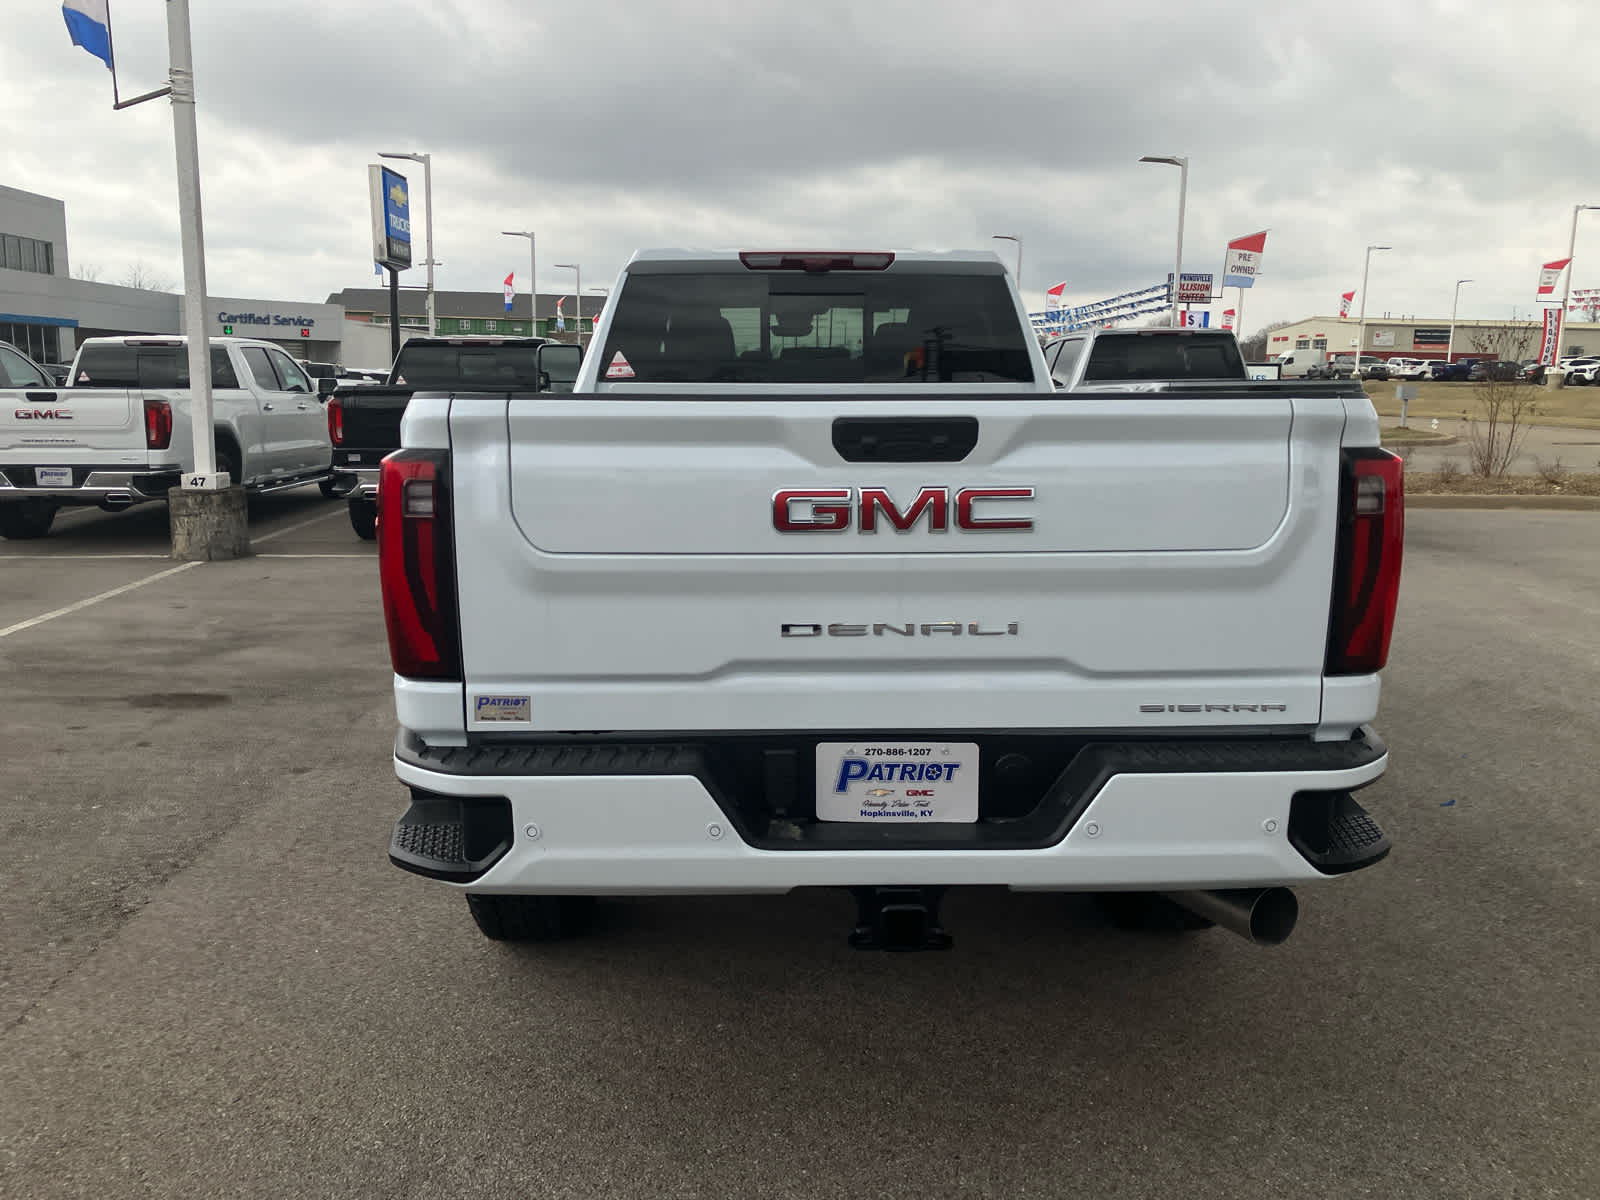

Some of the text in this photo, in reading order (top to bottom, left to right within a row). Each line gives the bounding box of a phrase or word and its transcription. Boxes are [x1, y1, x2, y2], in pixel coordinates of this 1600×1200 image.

[1238, 252, 1251, 262] PRE
[1230, 264, 1256, 275] OWNED
[218, 311, 315, 327] Certified Service
[14, 409, 73, 420] GMC
[190, 477, 206, 487] 47
[771, 486, 1035, 535] GMC
[780, 621, 1019, 637] DENALI
[1139, 703, 1287, 713] SIERRA
[864, 748, 932, 756] 270-886-1207
[905, 789, 935, 797] GMC
[860, 809, 934, 819] Hopkinsville, KY
